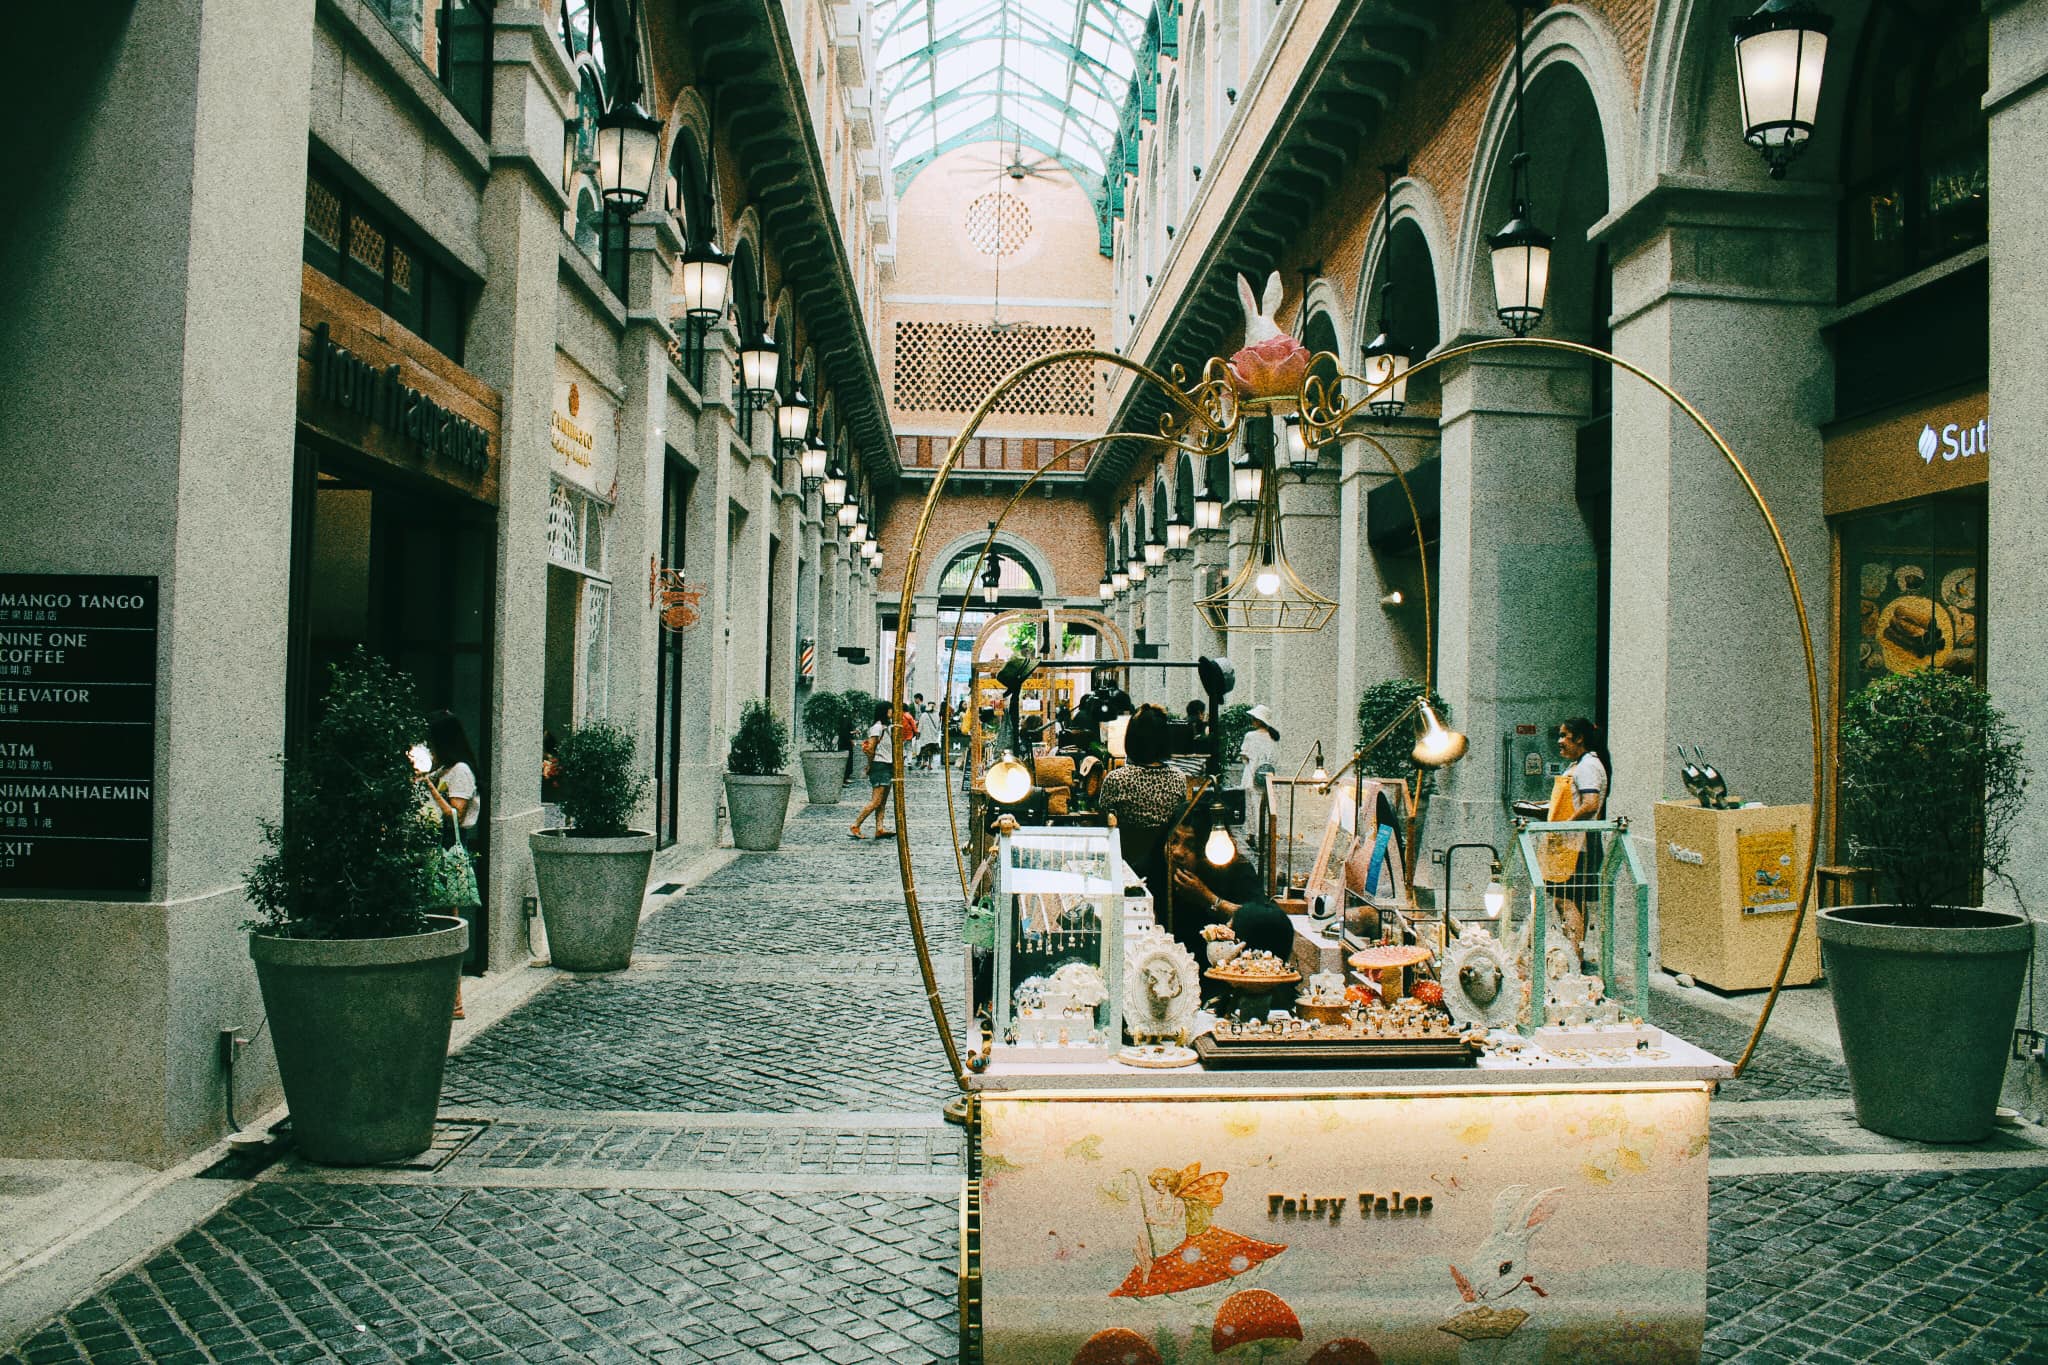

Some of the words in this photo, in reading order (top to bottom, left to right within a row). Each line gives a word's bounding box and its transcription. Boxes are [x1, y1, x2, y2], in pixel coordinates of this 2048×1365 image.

[1942, 416, 1990, 461] Sut
[1, 593, 72, 608] MANGO
[79, 594, 145, 609] TANGO
[0, 632, 43, 647] NINE
[49, 633, 88, 648] ONE
[0, 649, 65, 664] COFFEE
[0, 688, 90, 703] ELEVATOR
[0, 743, 35, 757] ATM
[0, 784, 149, 800] NIMMANHAEMIN
[0, 842, 34, 856] XIT
[0, 858, 15, 868] 口
[1267, 1193, 1346, 1220] Fairy
[1359, 1191, 1434, 1214] Tales
